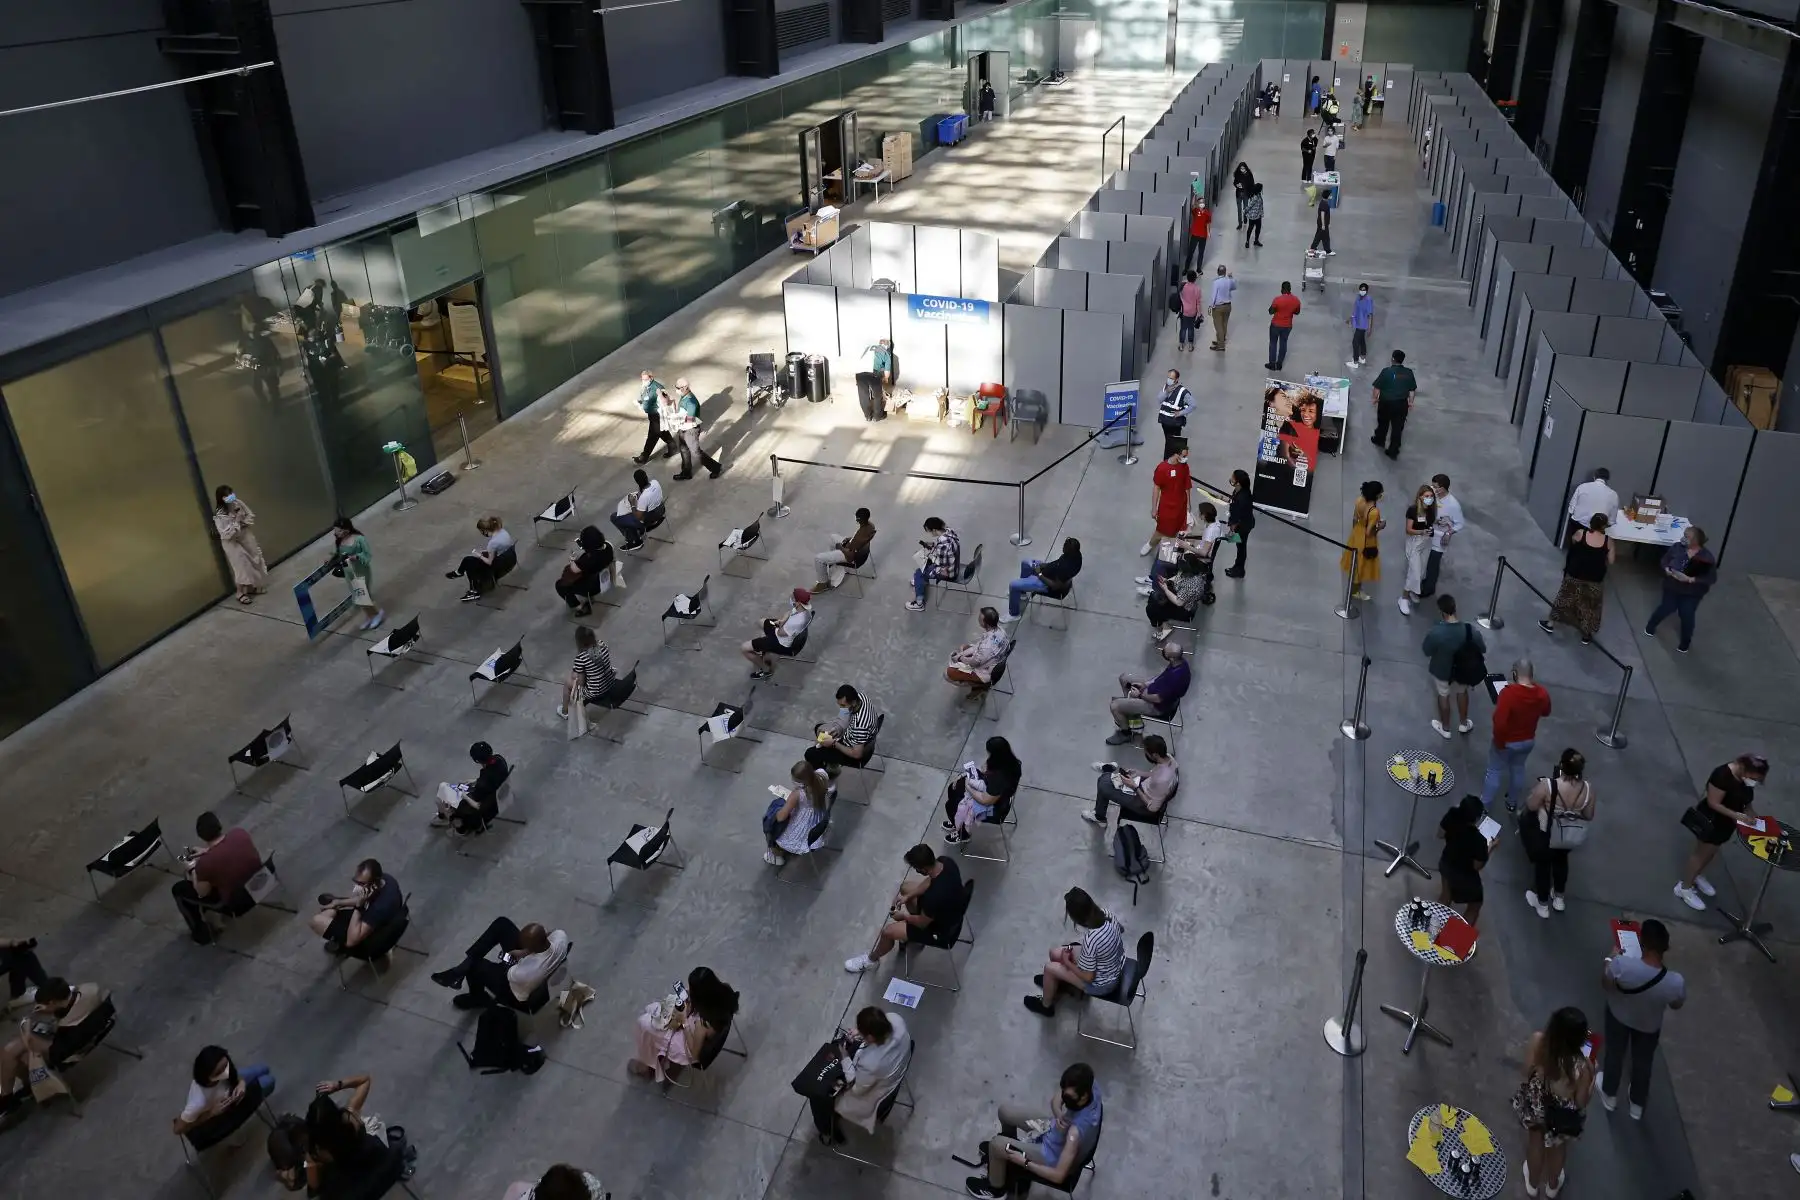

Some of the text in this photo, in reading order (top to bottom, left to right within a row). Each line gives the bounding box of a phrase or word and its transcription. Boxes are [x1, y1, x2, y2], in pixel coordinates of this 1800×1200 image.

[923, 299, 974, 311] COVID-19
[1109, 394, 1134, 402] COVID-19
[816, 1058, 840, 1082] CELINE
